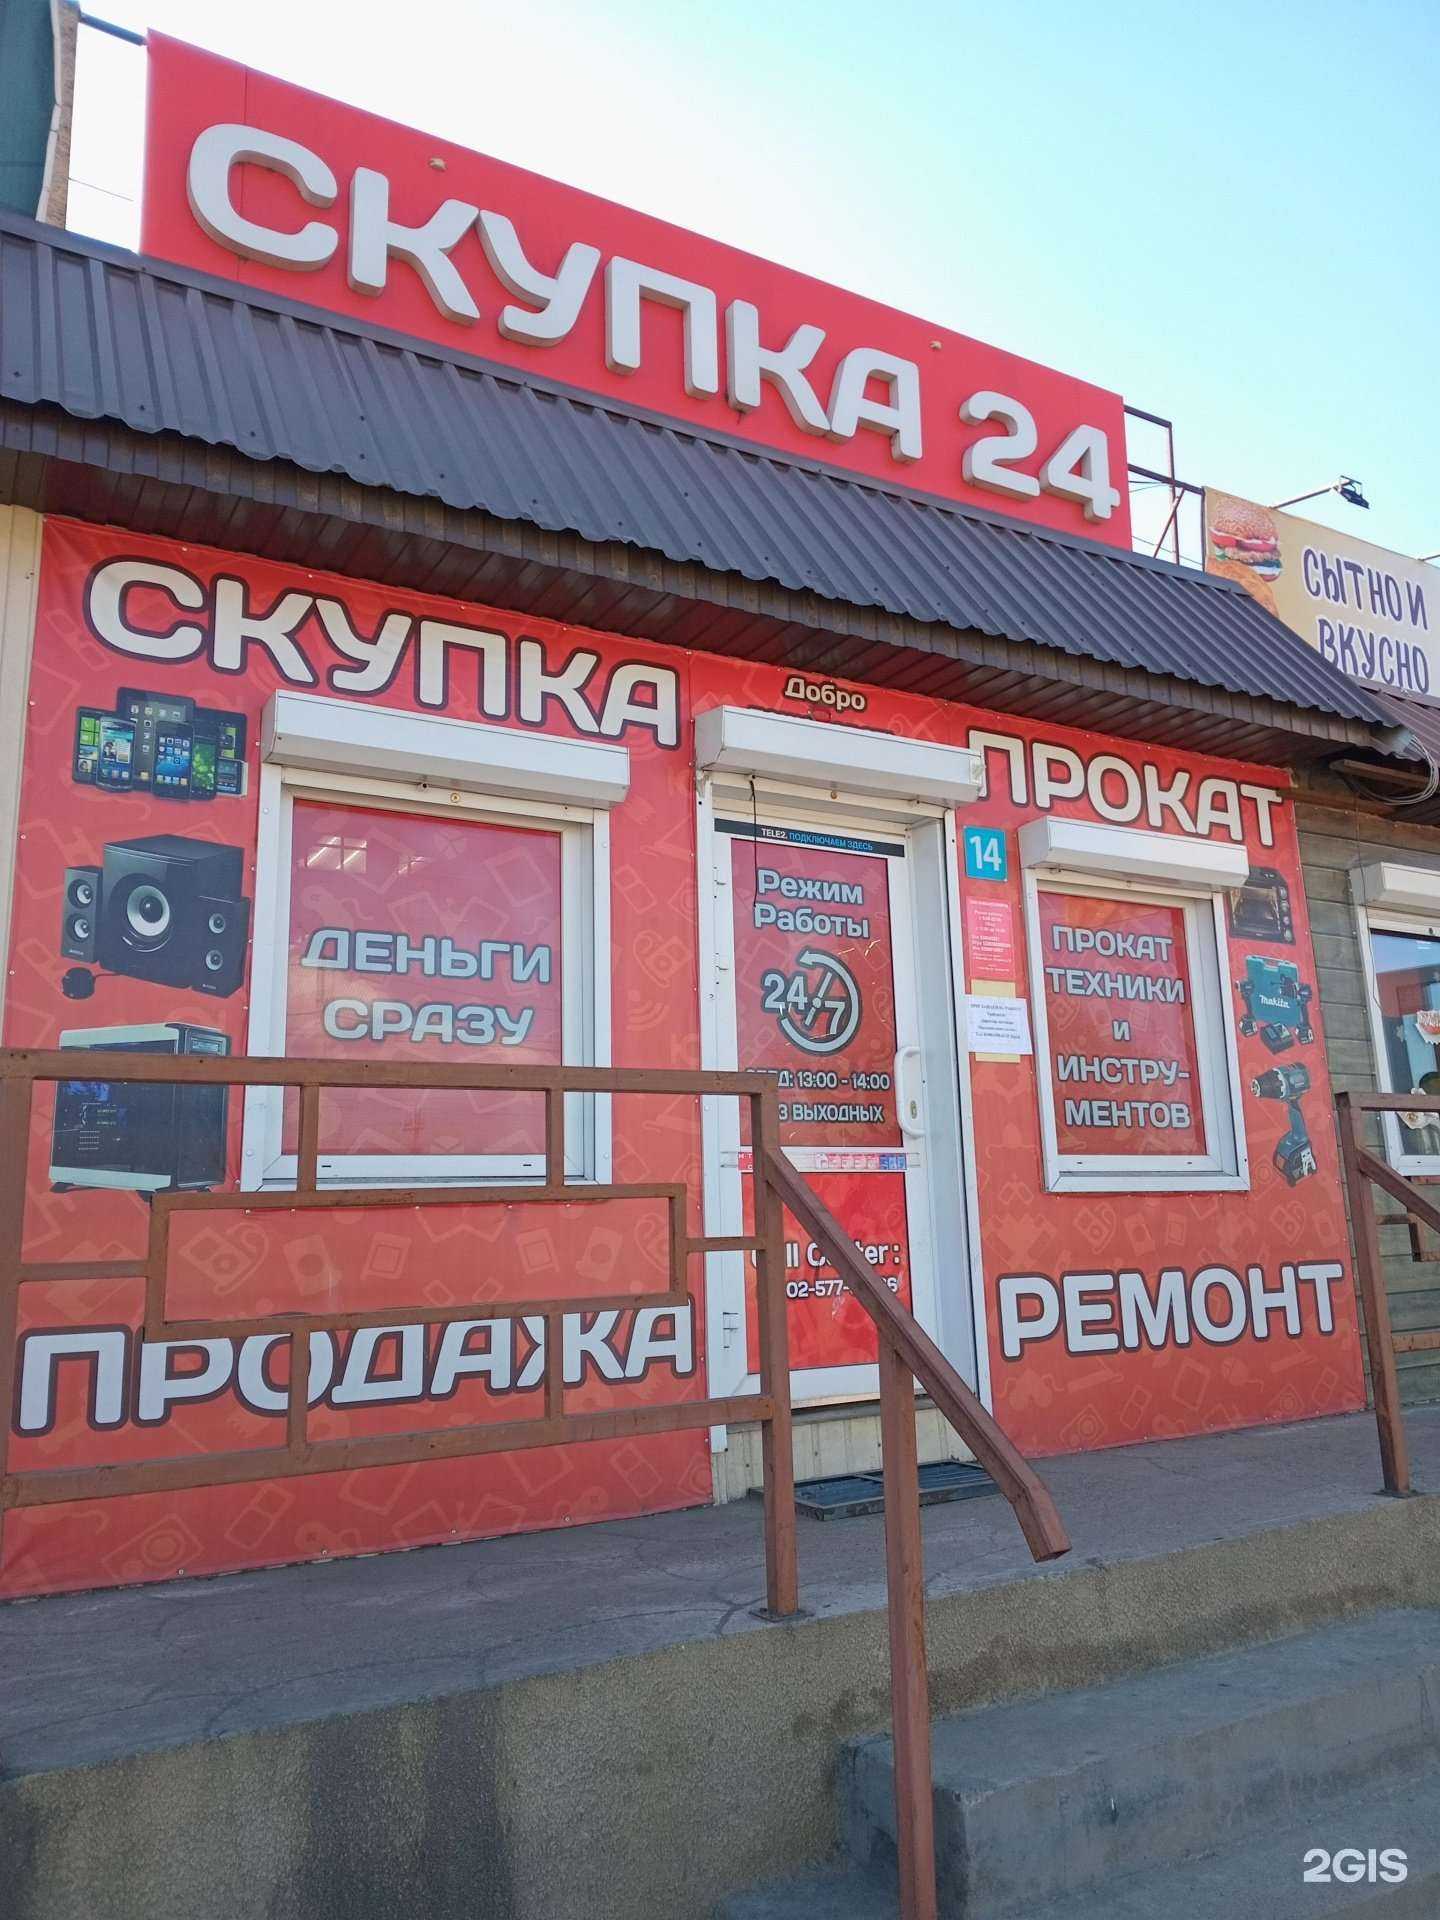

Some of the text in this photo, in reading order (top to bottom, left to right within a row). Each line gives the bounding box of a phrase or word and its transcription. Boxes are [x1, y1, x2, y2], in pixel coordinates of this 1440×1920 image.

[187, 124, 1121, 524] СКУПКА 24
[1303, 548, 1428, 631] СЫТНО И
[86, 559, 679, 748] СКУПКА
[1318, 618, 1429, 694] ВКУСНО
[784, 676, 866, 711] Добро
[968, 730, 1283, 847] ПРОКАТ
[789, 832, 846, 848] ПОДКЛЮЧАЕМ
[847, 840, 873, 851] ЗДЕСЬ
[970, 837, 1002, 872] 14
[757, 868, 863, 905] Режим
[754, 902, 870, 938] Работы
[301, 929, 551, 983] ДЕНЬГИ
[1052, 925, 1174, 963] ПРОКАТ
[1046, 966, 1186, 1004] ТЕХНИКИ
[323, 1000, 534, 1045] СРАЗУ
[797, 1070, 838, 1089] 13:00
[852, 1072, 891, 1090] 14:00
[1057, 1054, 1190, 1085] ИНСТРУ-
[792, 1103, 885, 1122] ВЫХОДНЫХ
[1065, 1100, 1192, 1129] МЕНТОВ
[1000, 1263, 1343, 1357] РЕМОНТ
[19, 1302, 693, 1431] ПРОДАЖА
